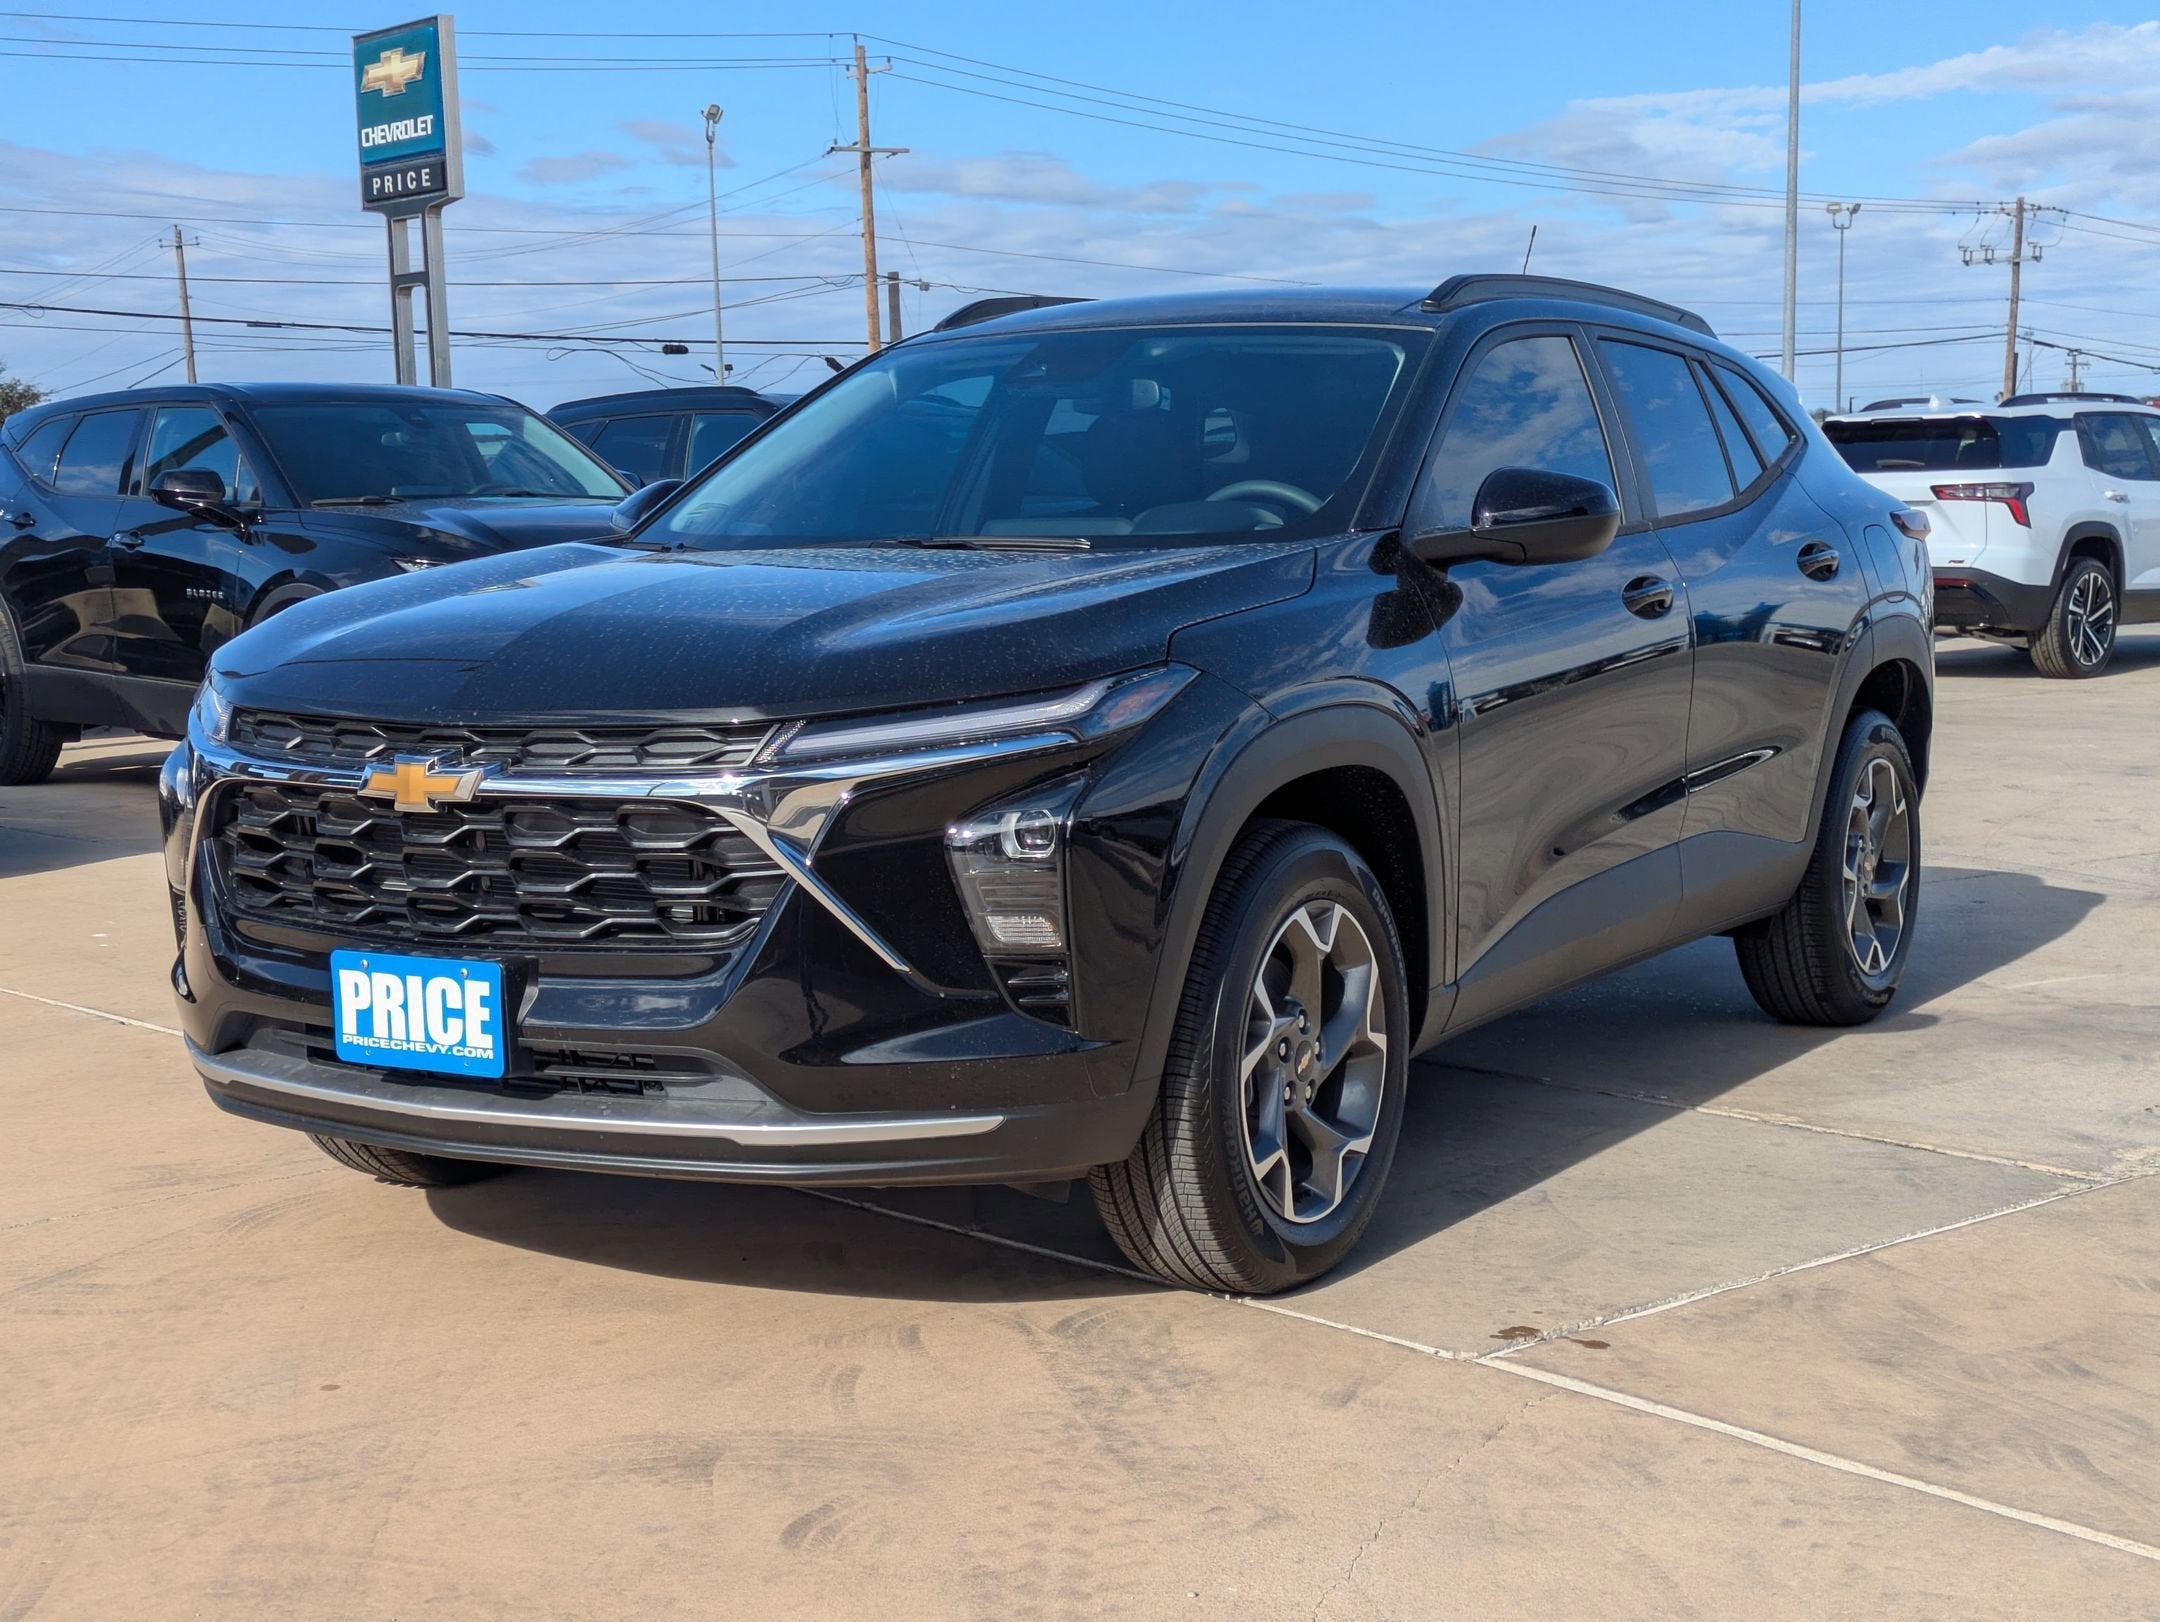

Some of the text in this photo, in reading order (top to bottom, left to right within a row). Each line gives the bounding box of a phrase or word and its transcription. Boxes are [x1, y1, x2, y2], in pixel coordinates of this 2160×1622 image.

[361, 115, 433, 147] CHEVROLET
[372, 168, 431, 195] PRICE
[338, 969, 493, 1049] PRICE
[342, 1034, 494, 1060] PRICECHEVY.COM
